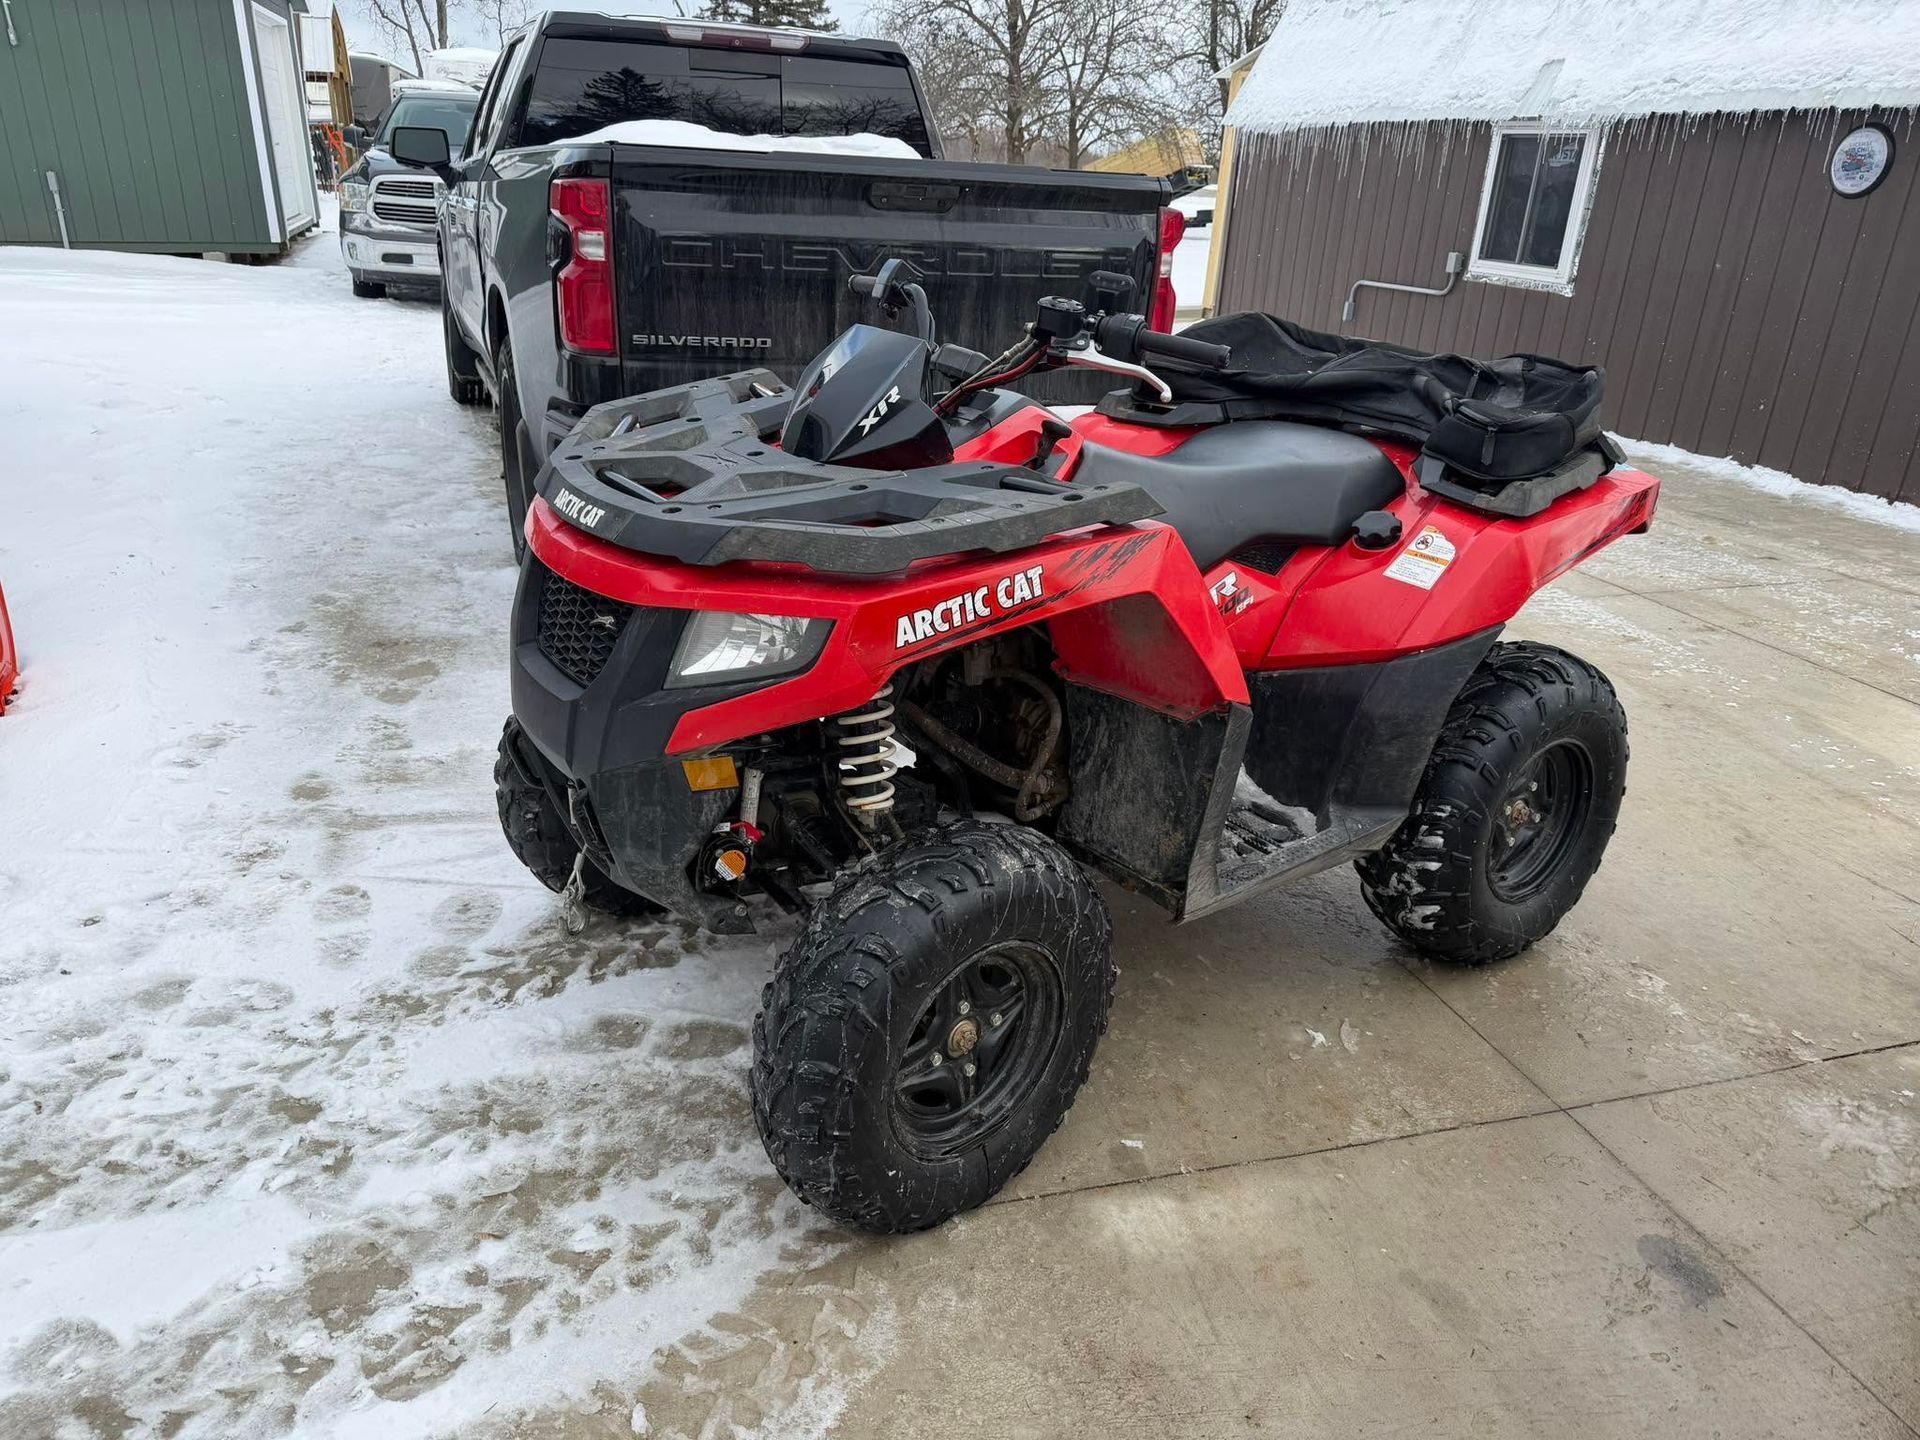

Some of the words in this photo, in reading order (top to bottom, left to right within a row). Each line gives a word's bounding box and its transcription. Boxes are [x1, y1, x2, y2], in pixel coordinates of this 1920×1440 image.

[631, 333, 773, 349] SILVERADO
[857, 385, 902, 437] XR
[553, 487, 586, 520] ARCTIC
[579, 504, 606, 529] CAT
[895, 585, 992, 649] ARCTIC
[996, 564, 1044, 610] CAT
[1235, 595, 1255, 615] EFI
